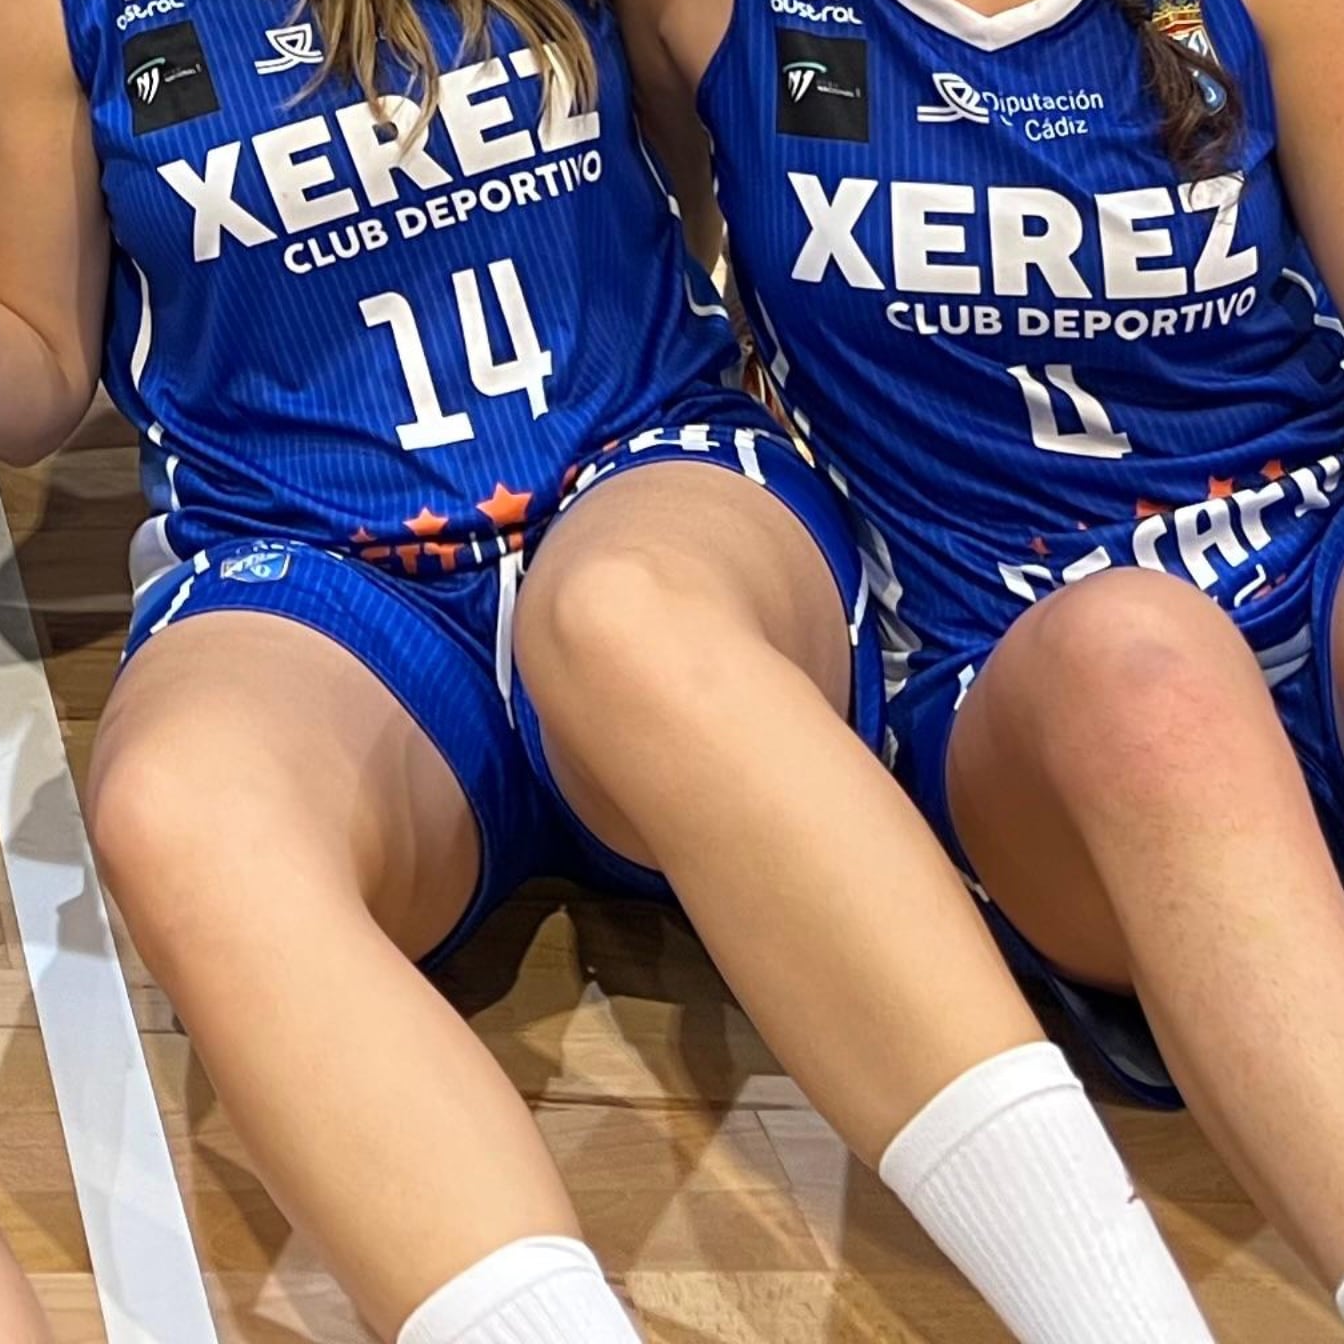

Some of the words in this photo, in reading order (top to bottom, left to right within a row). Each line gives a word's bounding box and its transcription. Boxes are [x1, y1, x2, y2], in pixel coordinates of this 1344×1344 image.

[157, 42, 601, 263] XEREZ
[1024, 116, 1089, 142] Cádiz
[283, 218, 389, 275] CLUB
[397, 149, 603, 240] DEPORTIVO
[787, 170, 1260, 300] XEREZ
[358, 258, 553, 451] 14
[886, 300, 1003, 335] CLUB
[1018, 289, 1257, 341] DEPORTIVO
